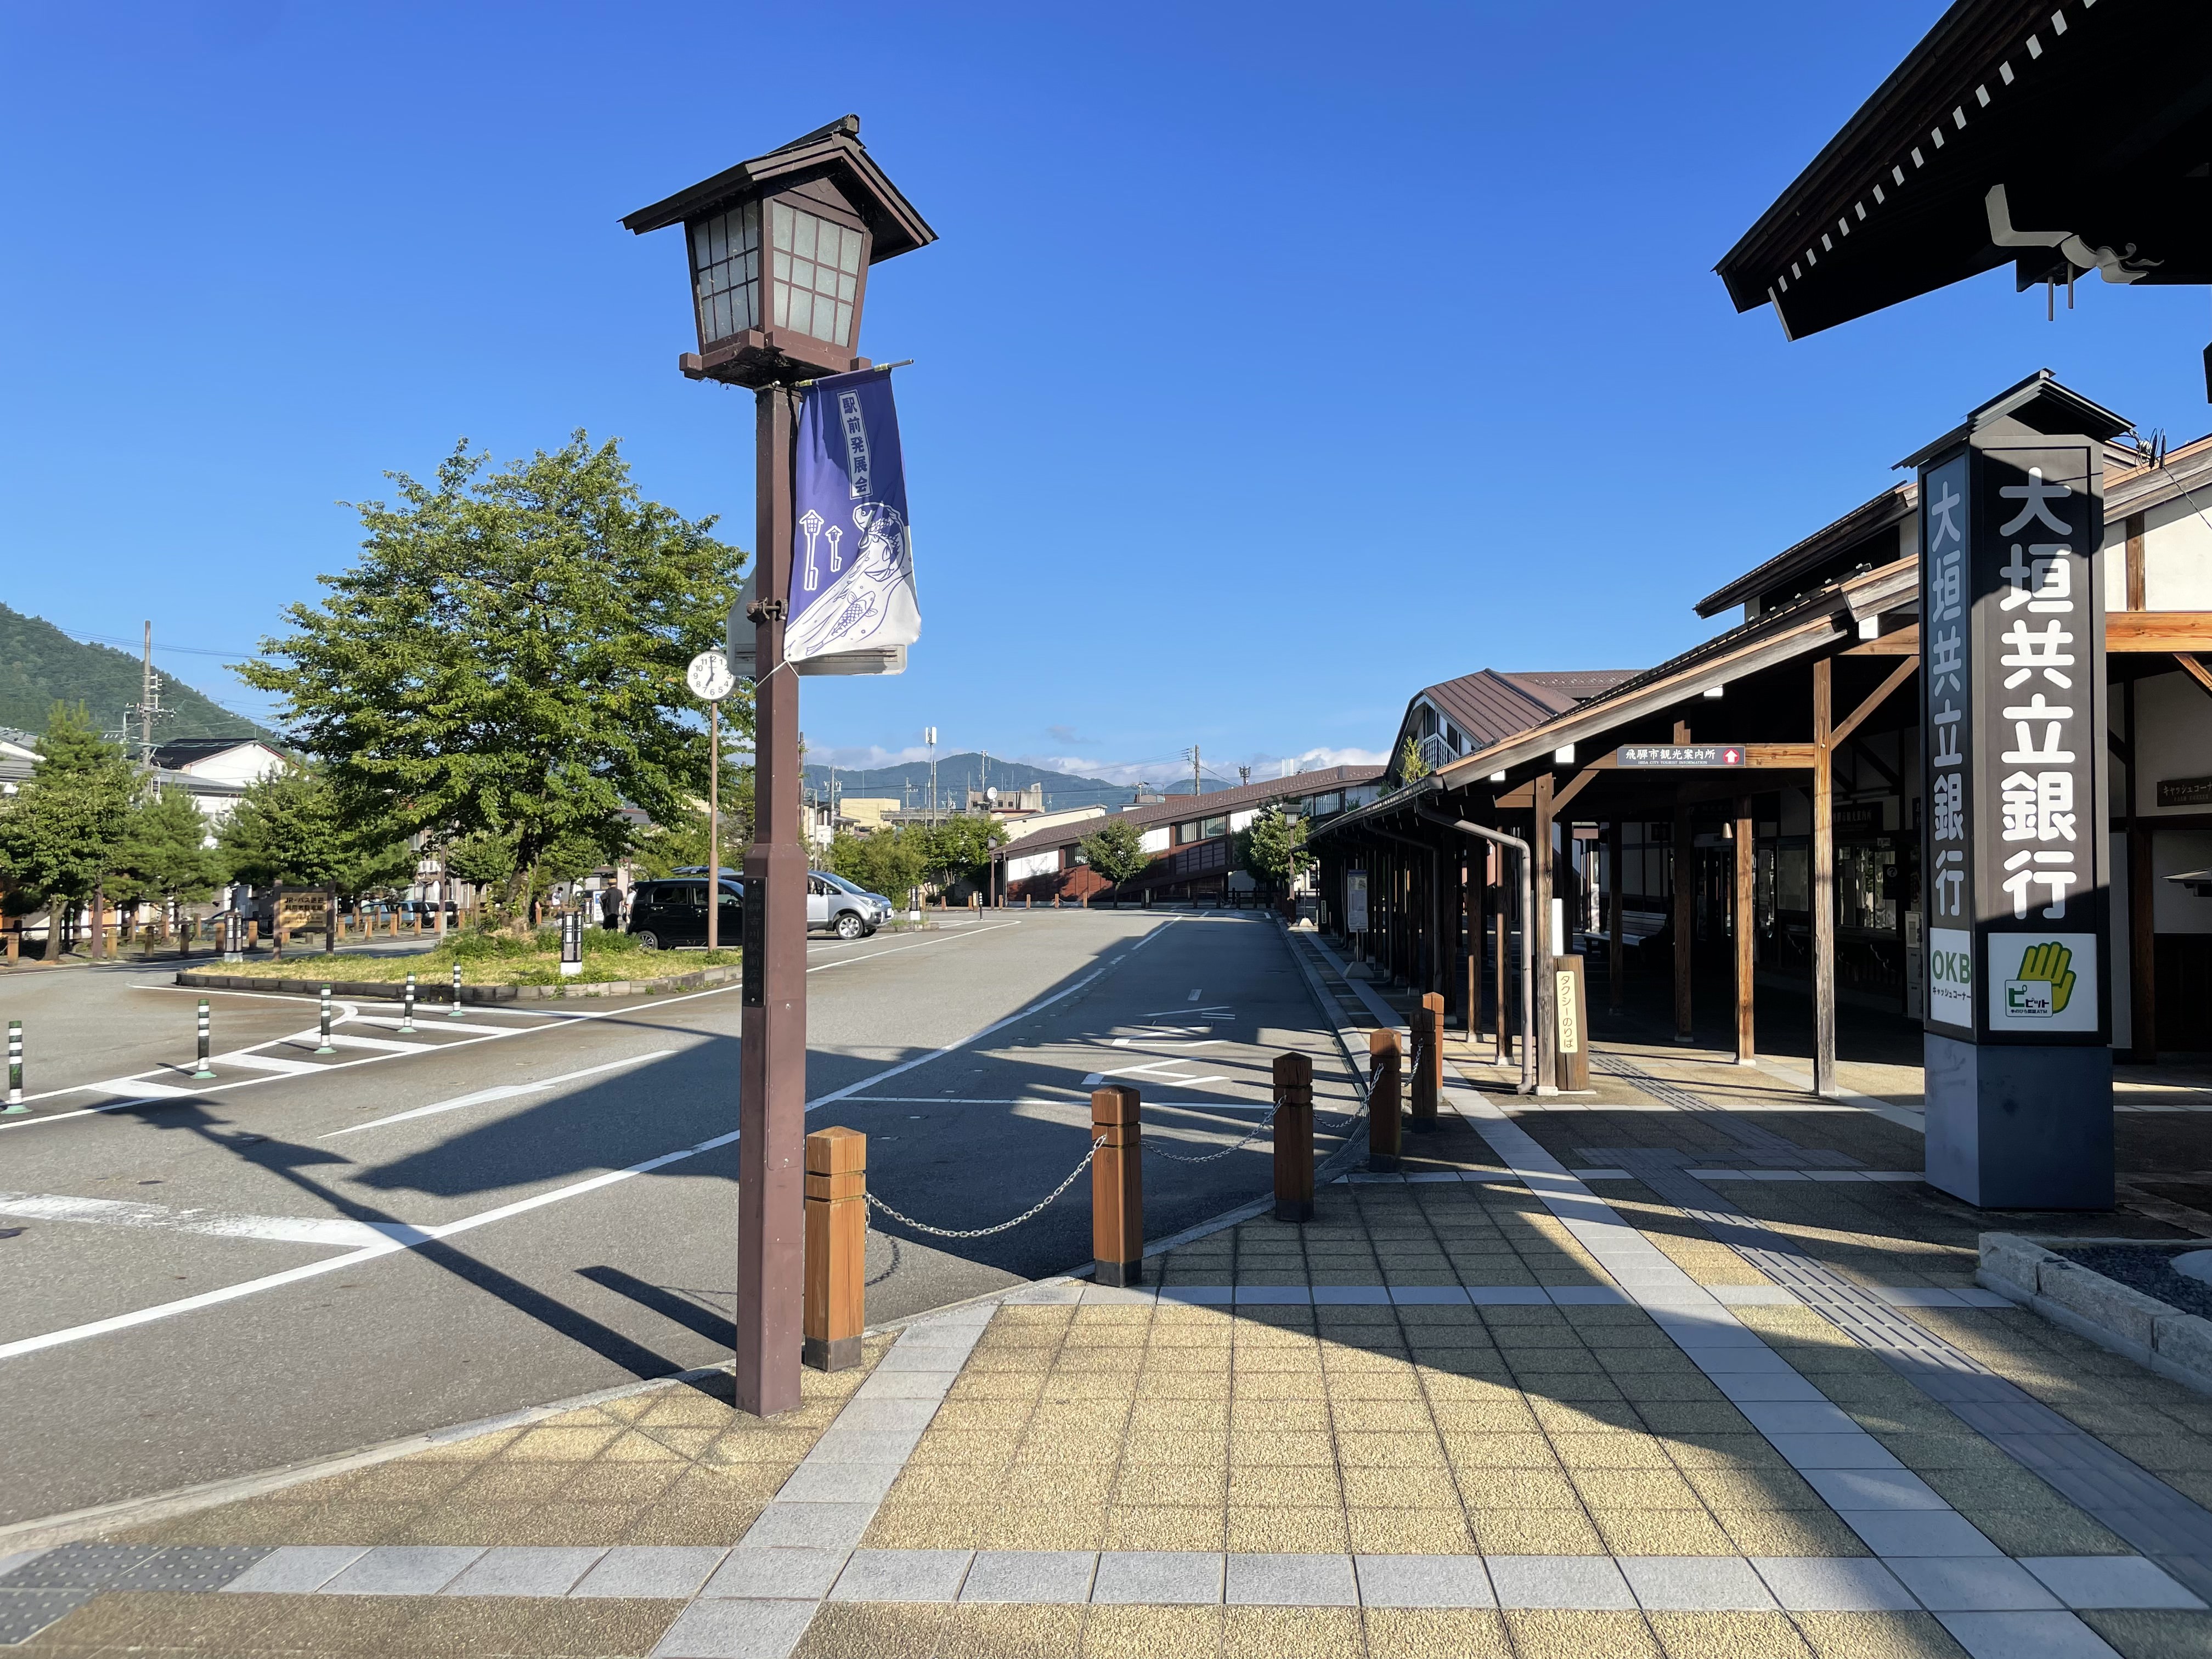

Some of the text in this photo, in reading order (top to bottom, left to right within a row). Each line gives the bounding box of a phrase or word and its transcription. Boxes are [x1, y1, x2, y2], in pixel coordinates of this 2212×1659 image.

[843, 396, 870, 493] 駅前発展会
[1931, 481, 1965, 917] 大垣共立銀行
[1999, 467, 2077, 919] 大垣共立銀行
[1932, 950, 1971, 984] OKB
[1933, 986, 1971, 1001] キャッシュコーナー
[1561, 975, 1573, 1048] タクシーのりば
